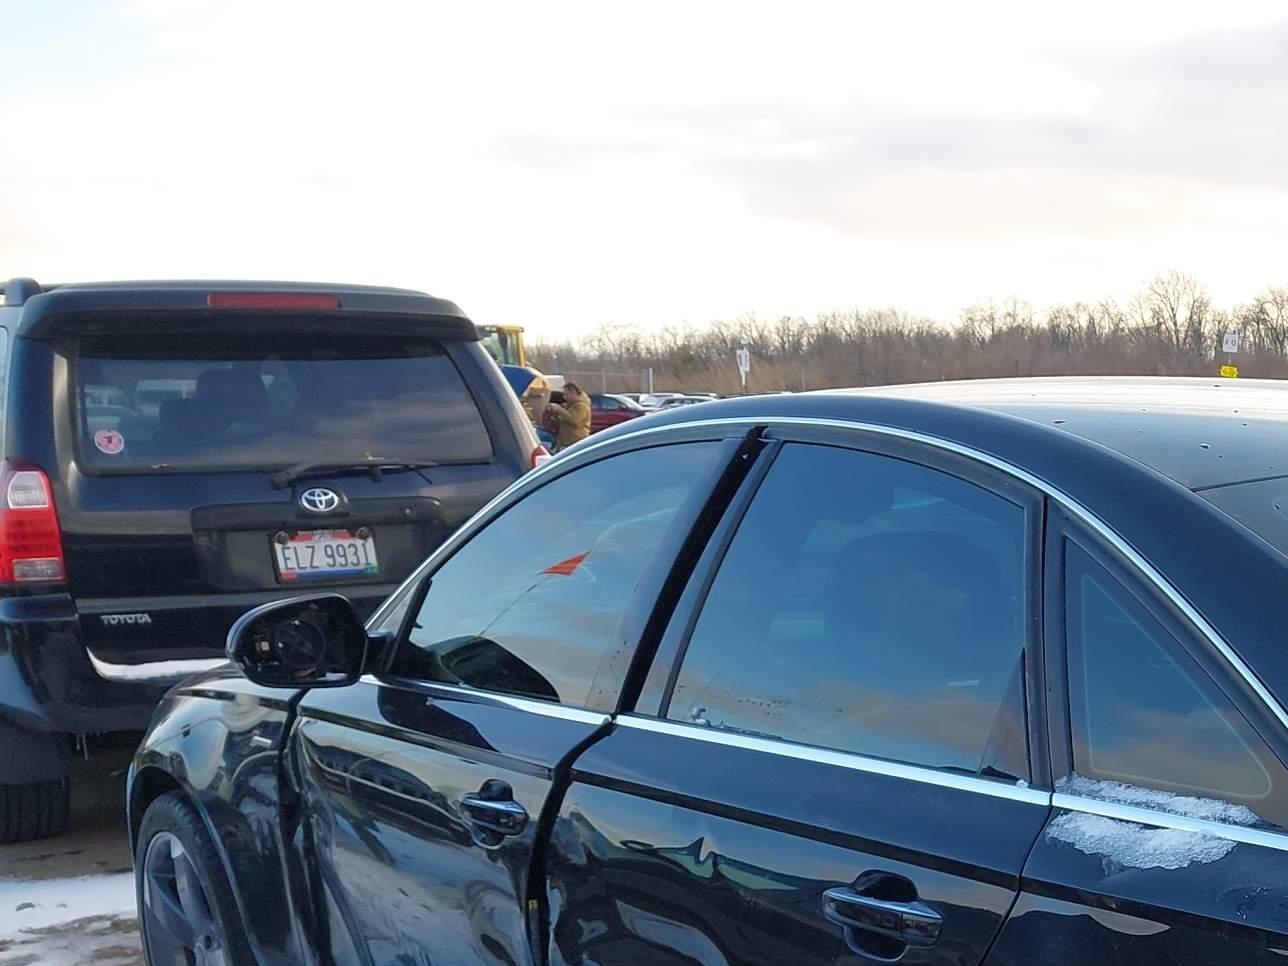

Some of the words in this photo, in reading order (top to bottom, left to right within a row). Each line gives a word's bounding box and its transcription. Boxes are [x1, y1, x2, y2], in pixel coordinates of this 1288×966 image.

[281, 545, 319, 570] ELZ
[324, 543, 372, 567] 9931
[100, 613, 152, 625] TOYOTA
